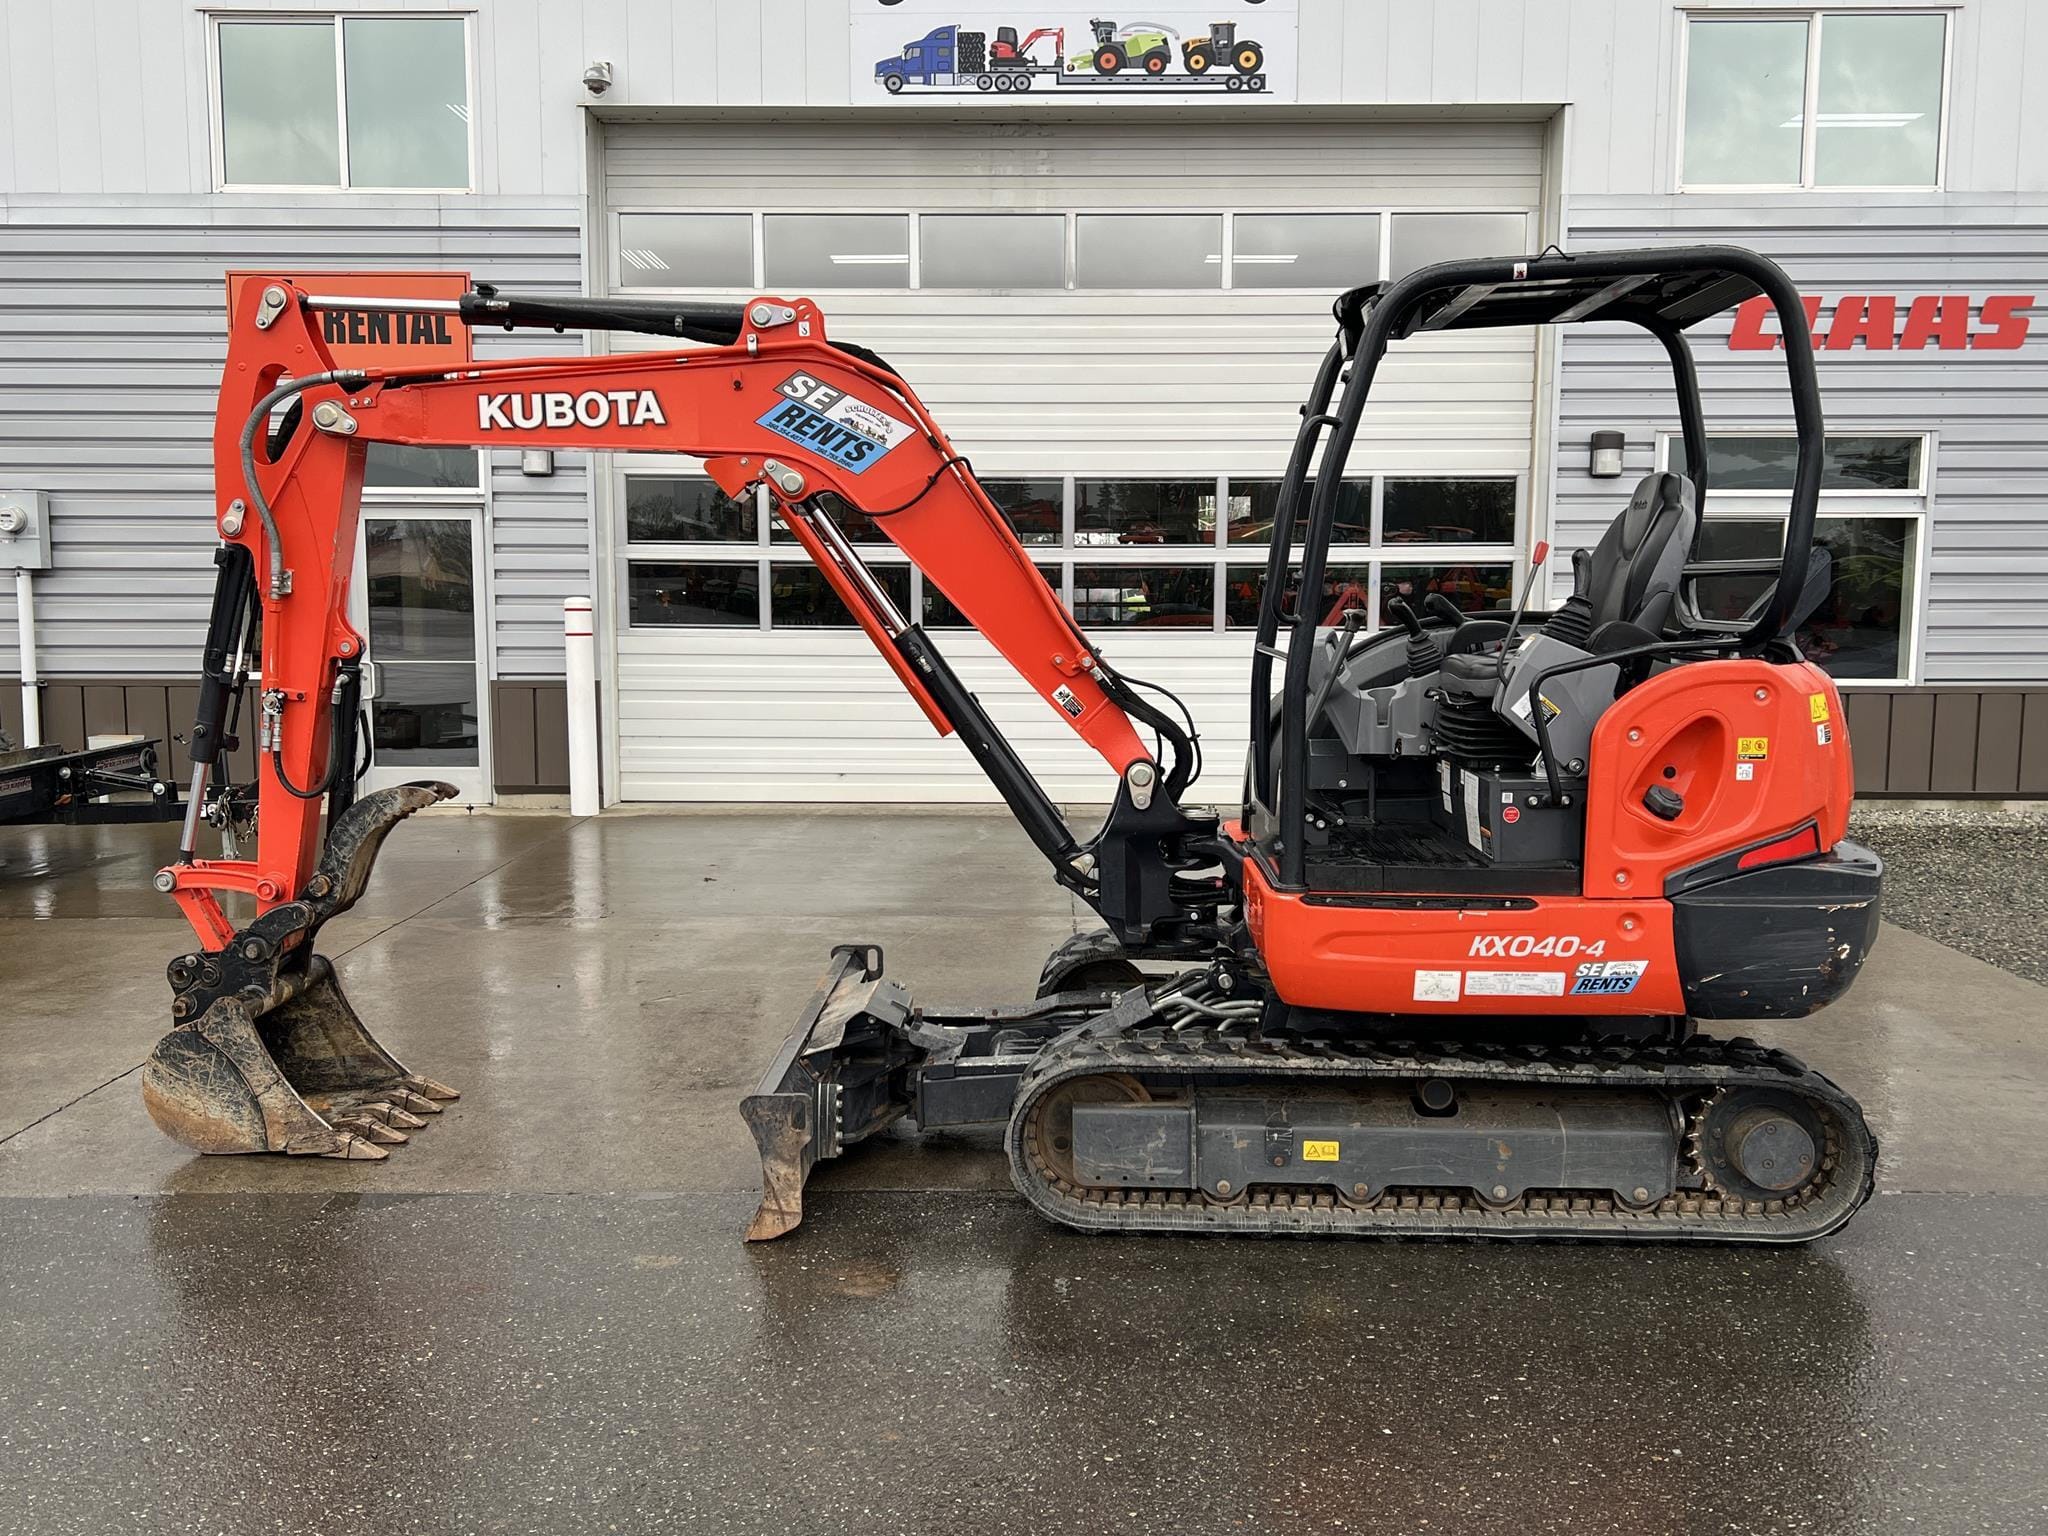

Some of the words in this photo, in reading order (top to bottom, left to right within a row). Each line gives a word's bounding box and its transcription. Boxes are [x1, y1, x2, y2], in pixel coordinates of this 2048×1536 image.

[783, 375, 839, 410] SE
[477, 389, 667, 431] KUBOTA
[773, 403, 876, 462] RENTS
[1467, 935, 1607, 958] KX040-4
[1575, 962, 1604, 977] SE
[1577, 977, 1633, 991] RENTS
